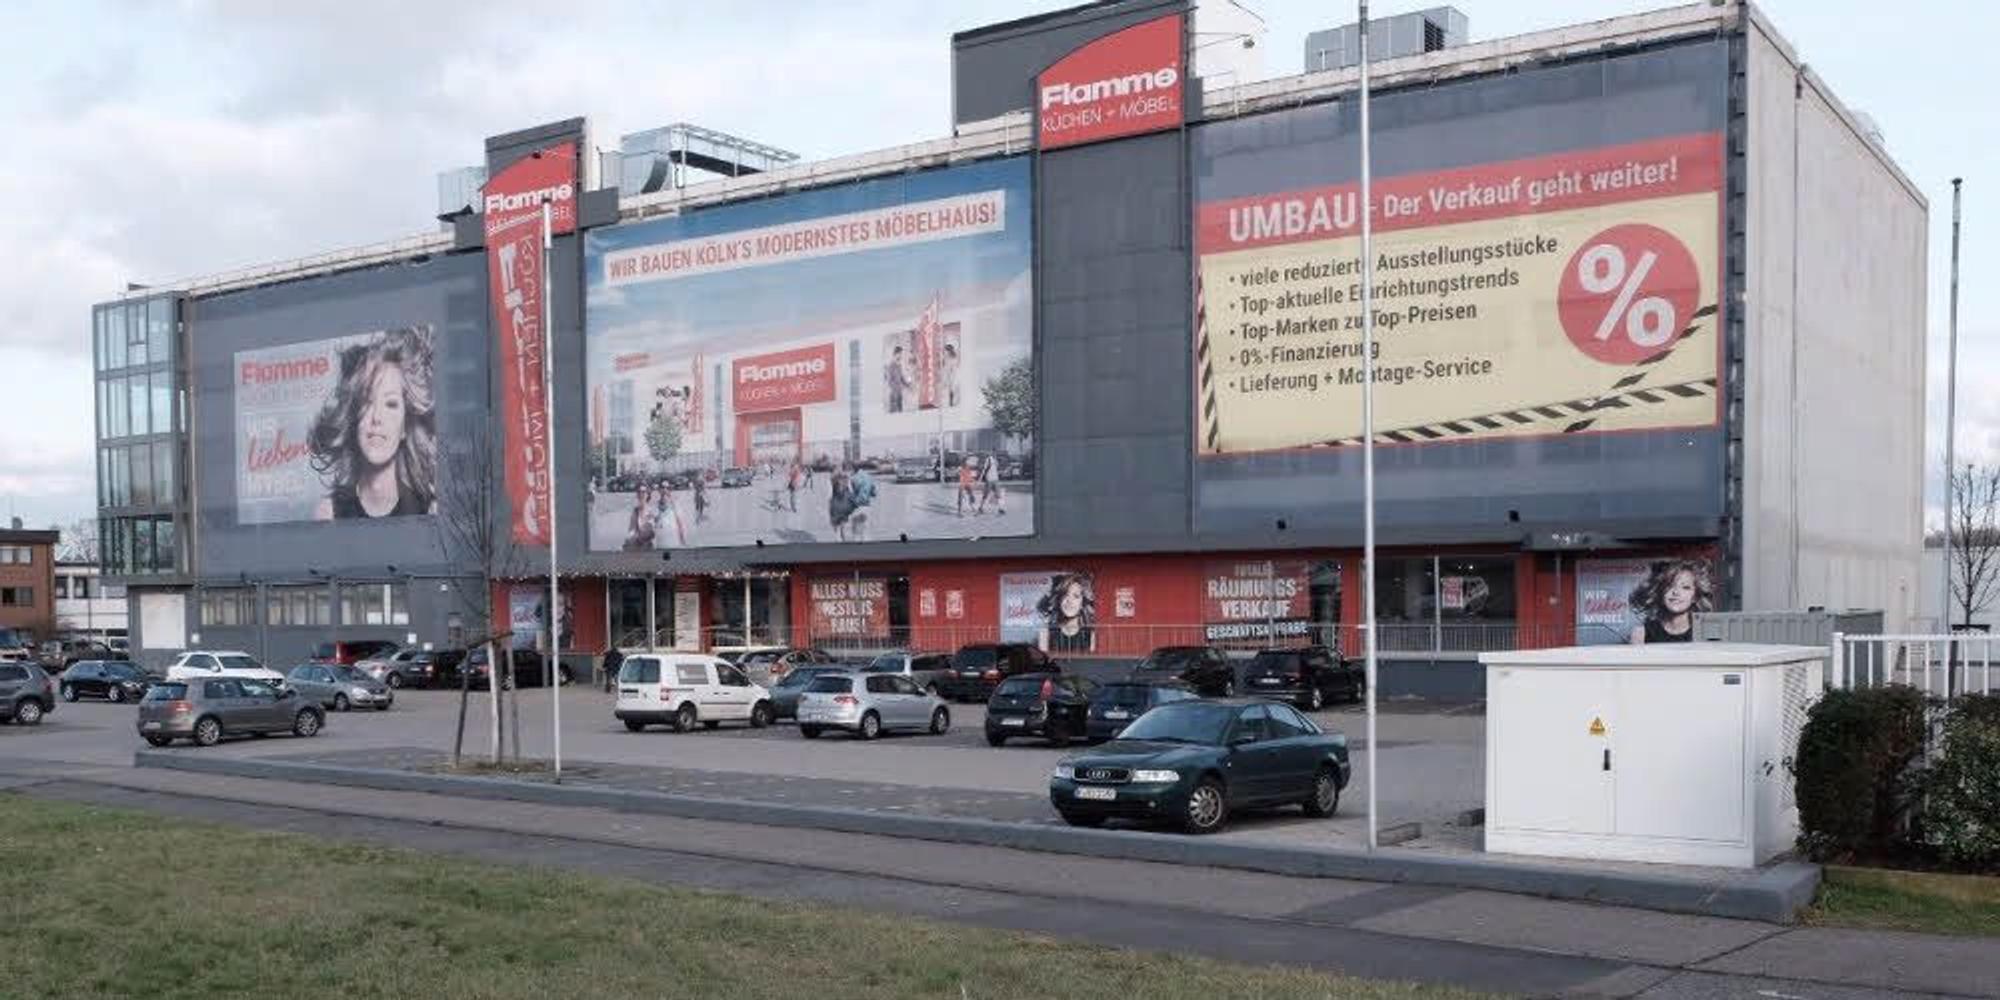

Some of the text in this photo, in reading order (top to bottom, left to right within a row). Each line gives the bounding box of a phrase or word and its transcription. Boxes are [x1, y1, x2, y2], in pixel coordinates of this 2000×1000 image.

[1041, 66, 1178, 110] Flamme
[1041, 106, 1102, 131] KÜCHEN
[1119, 95, 1178, 120] MÖBEL
[485, 183, 573, 214] Flamme
[1229, 191, 1354, 243] UMBAU
[1384, 193, 1422, 218] Der
[1427, 175, 1522, 213] Verkauf
[1528, 171, 1583, 206] geht
[1589, 156, 1677, 191] weiter!
[609, 256, 636, 278] WIR
[641, 249, 691, 275] BAUEN
[757, 221, 870, 257] MODERNSTES
[876, 200, 996, 240] MÖBELHAUS!
[1240, 234, 1558, 287] viele reduziert Ausstellungsstücke
[1240, 287, 1344, 315] Top-aktuelle
[1240, 302, 1477, 341] Top-Marken zu Top-Preisen
[240, 357, 329, 385] Flamme
[739, 356, 826, 384] Flamme
[1240, 373, 1317, 393] Lieferung
[1323, 373, 1333, 384] +
